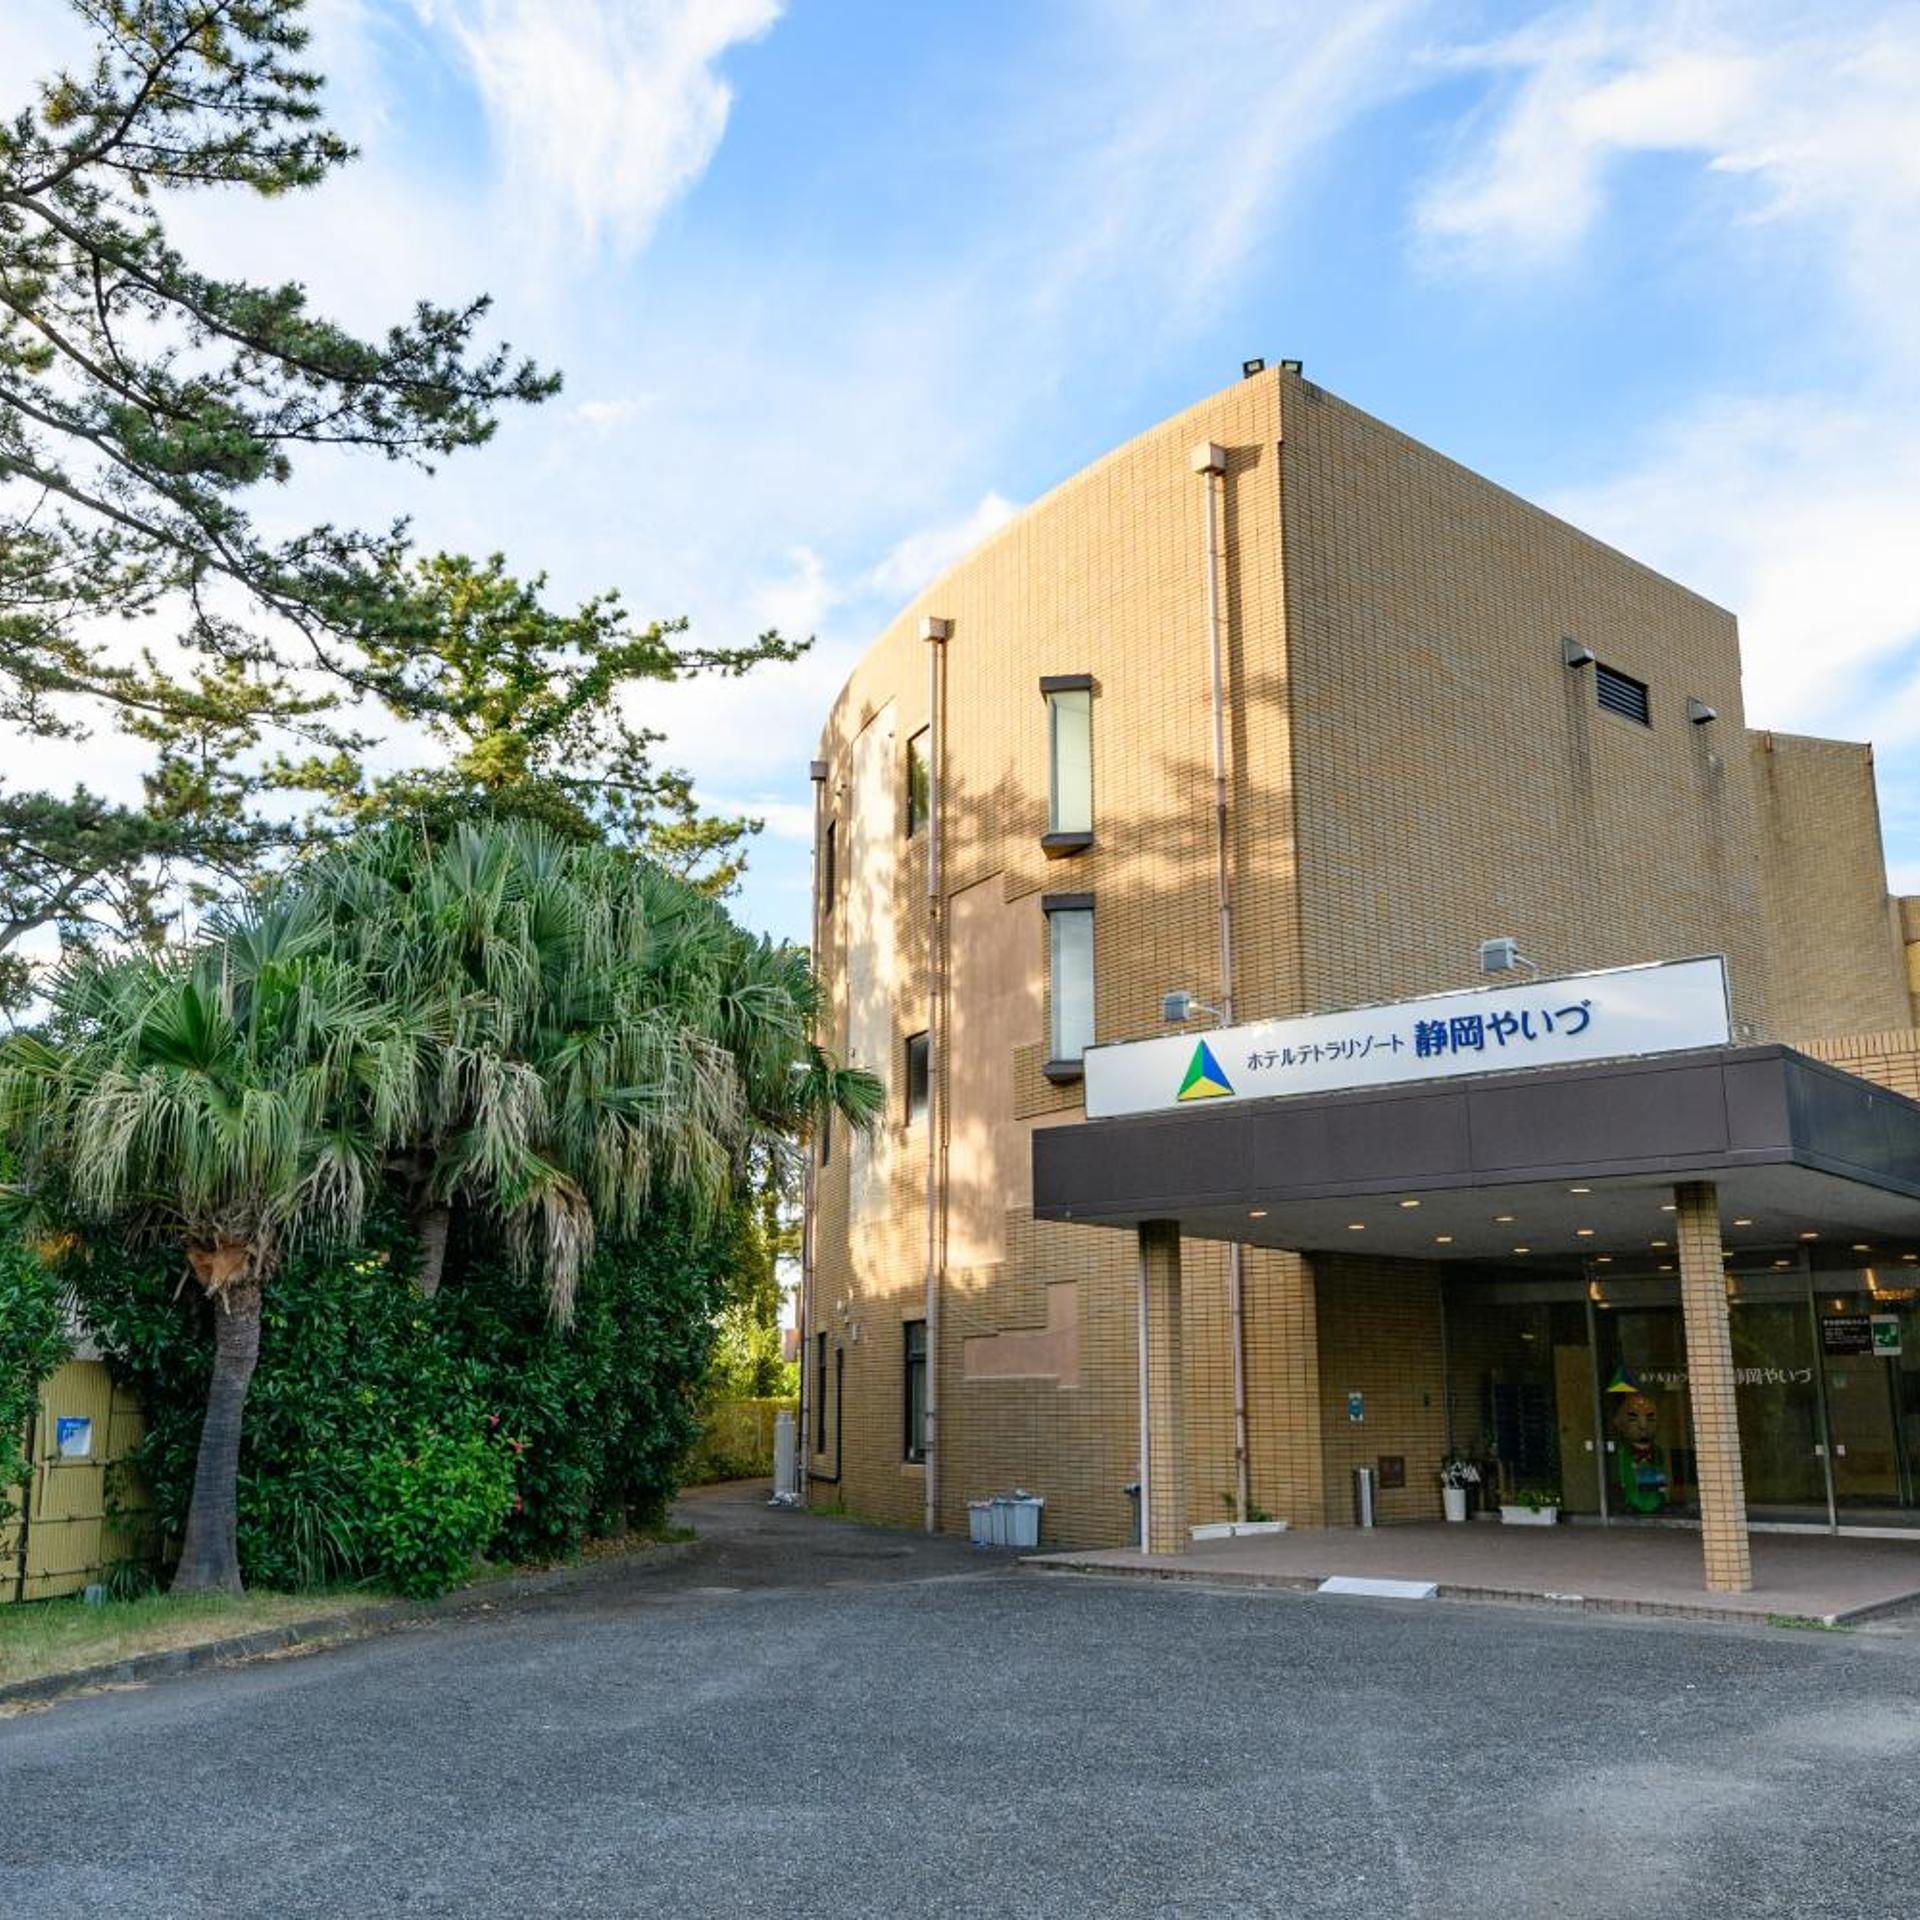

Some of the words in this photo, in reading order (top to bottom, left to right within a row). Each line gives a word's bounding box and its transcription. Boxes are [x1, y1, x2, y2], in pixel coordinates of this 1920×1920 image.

[1247, 1033, 1405, 1071] ホテルテトラリゾート
[1414, 999, 1591, 1058] 静岡やいづ
